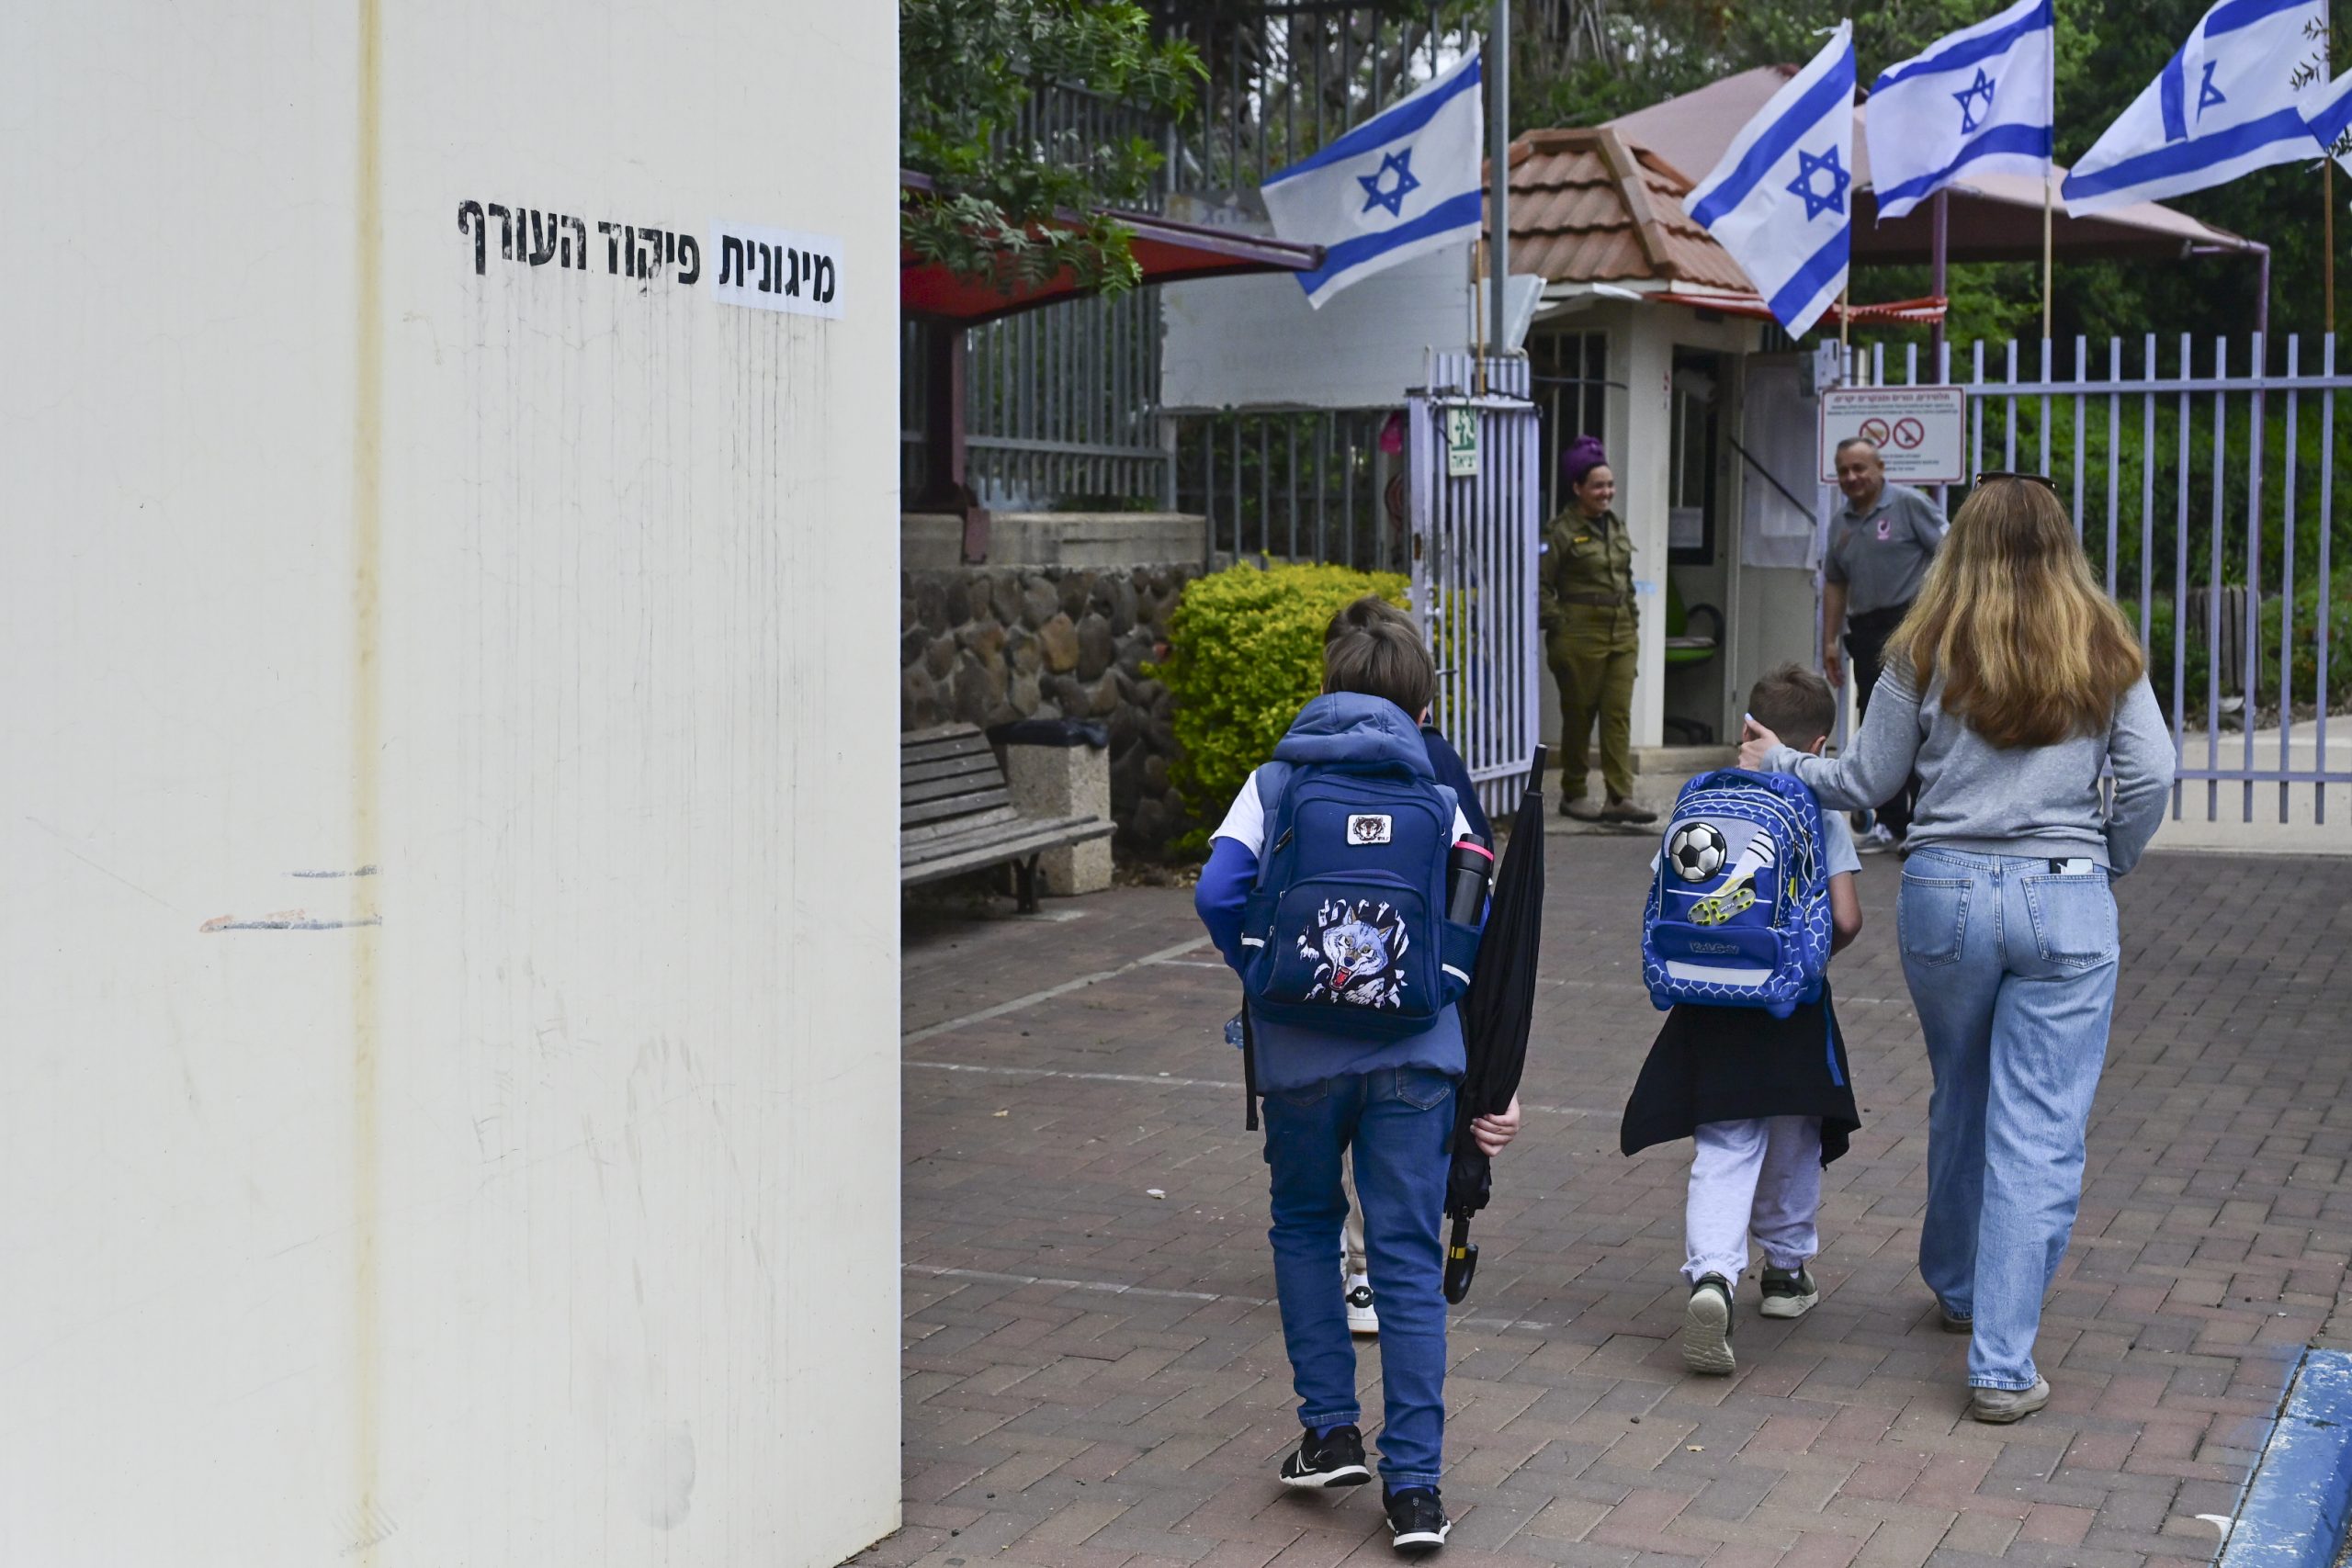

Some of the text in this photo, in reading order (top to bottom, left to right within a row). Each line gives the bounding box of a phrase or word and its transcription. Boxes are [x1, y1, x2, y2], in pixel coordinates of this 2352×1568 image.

[458, 199, 835, 304] מיגונית פיקוד העורף
